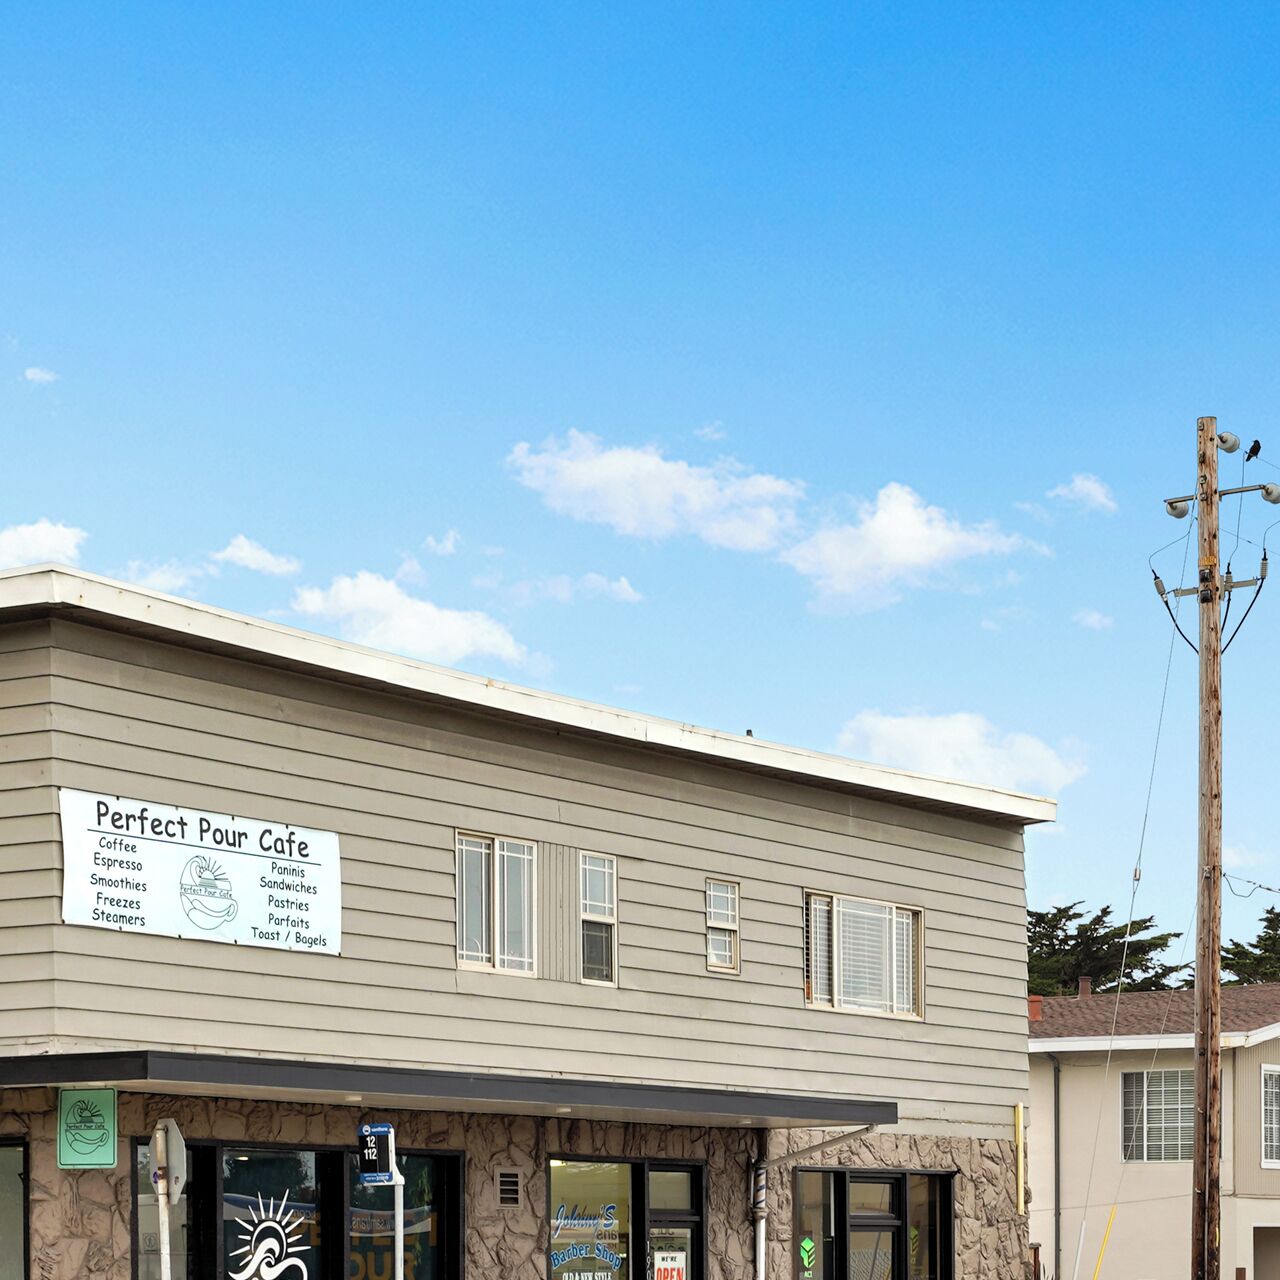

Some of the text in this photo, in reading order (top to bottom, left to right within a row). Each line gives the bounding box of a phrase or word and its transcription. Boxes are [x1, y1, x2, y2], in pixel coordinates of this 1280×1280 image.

[96, 800, 310, 858] Perfect Pour Cafe
[99, 836, 137, 853] Coffee
[93, 851, 143, 871] Espresso
[271, 861, 306, 878] Paninis
[90, 873, 147, 892] Smoothies
[259, 876, 318, 895] Sandwiches
[96, 892, 141, 910] Freezes
[268, 894, 309, 912] Pastries
[92, 908, 146, 927] Steamers
[268, 912, 310, 930] Parfaits
[251, 926, 327, 949] Toast / Bagels
[366, 1135, 376, 1148] 12
[363, 1148, 378, 1160] 112
[550, 1240, 622, 1271] Barber Shop
[661, 1255, 678, 1263] WE'RE
